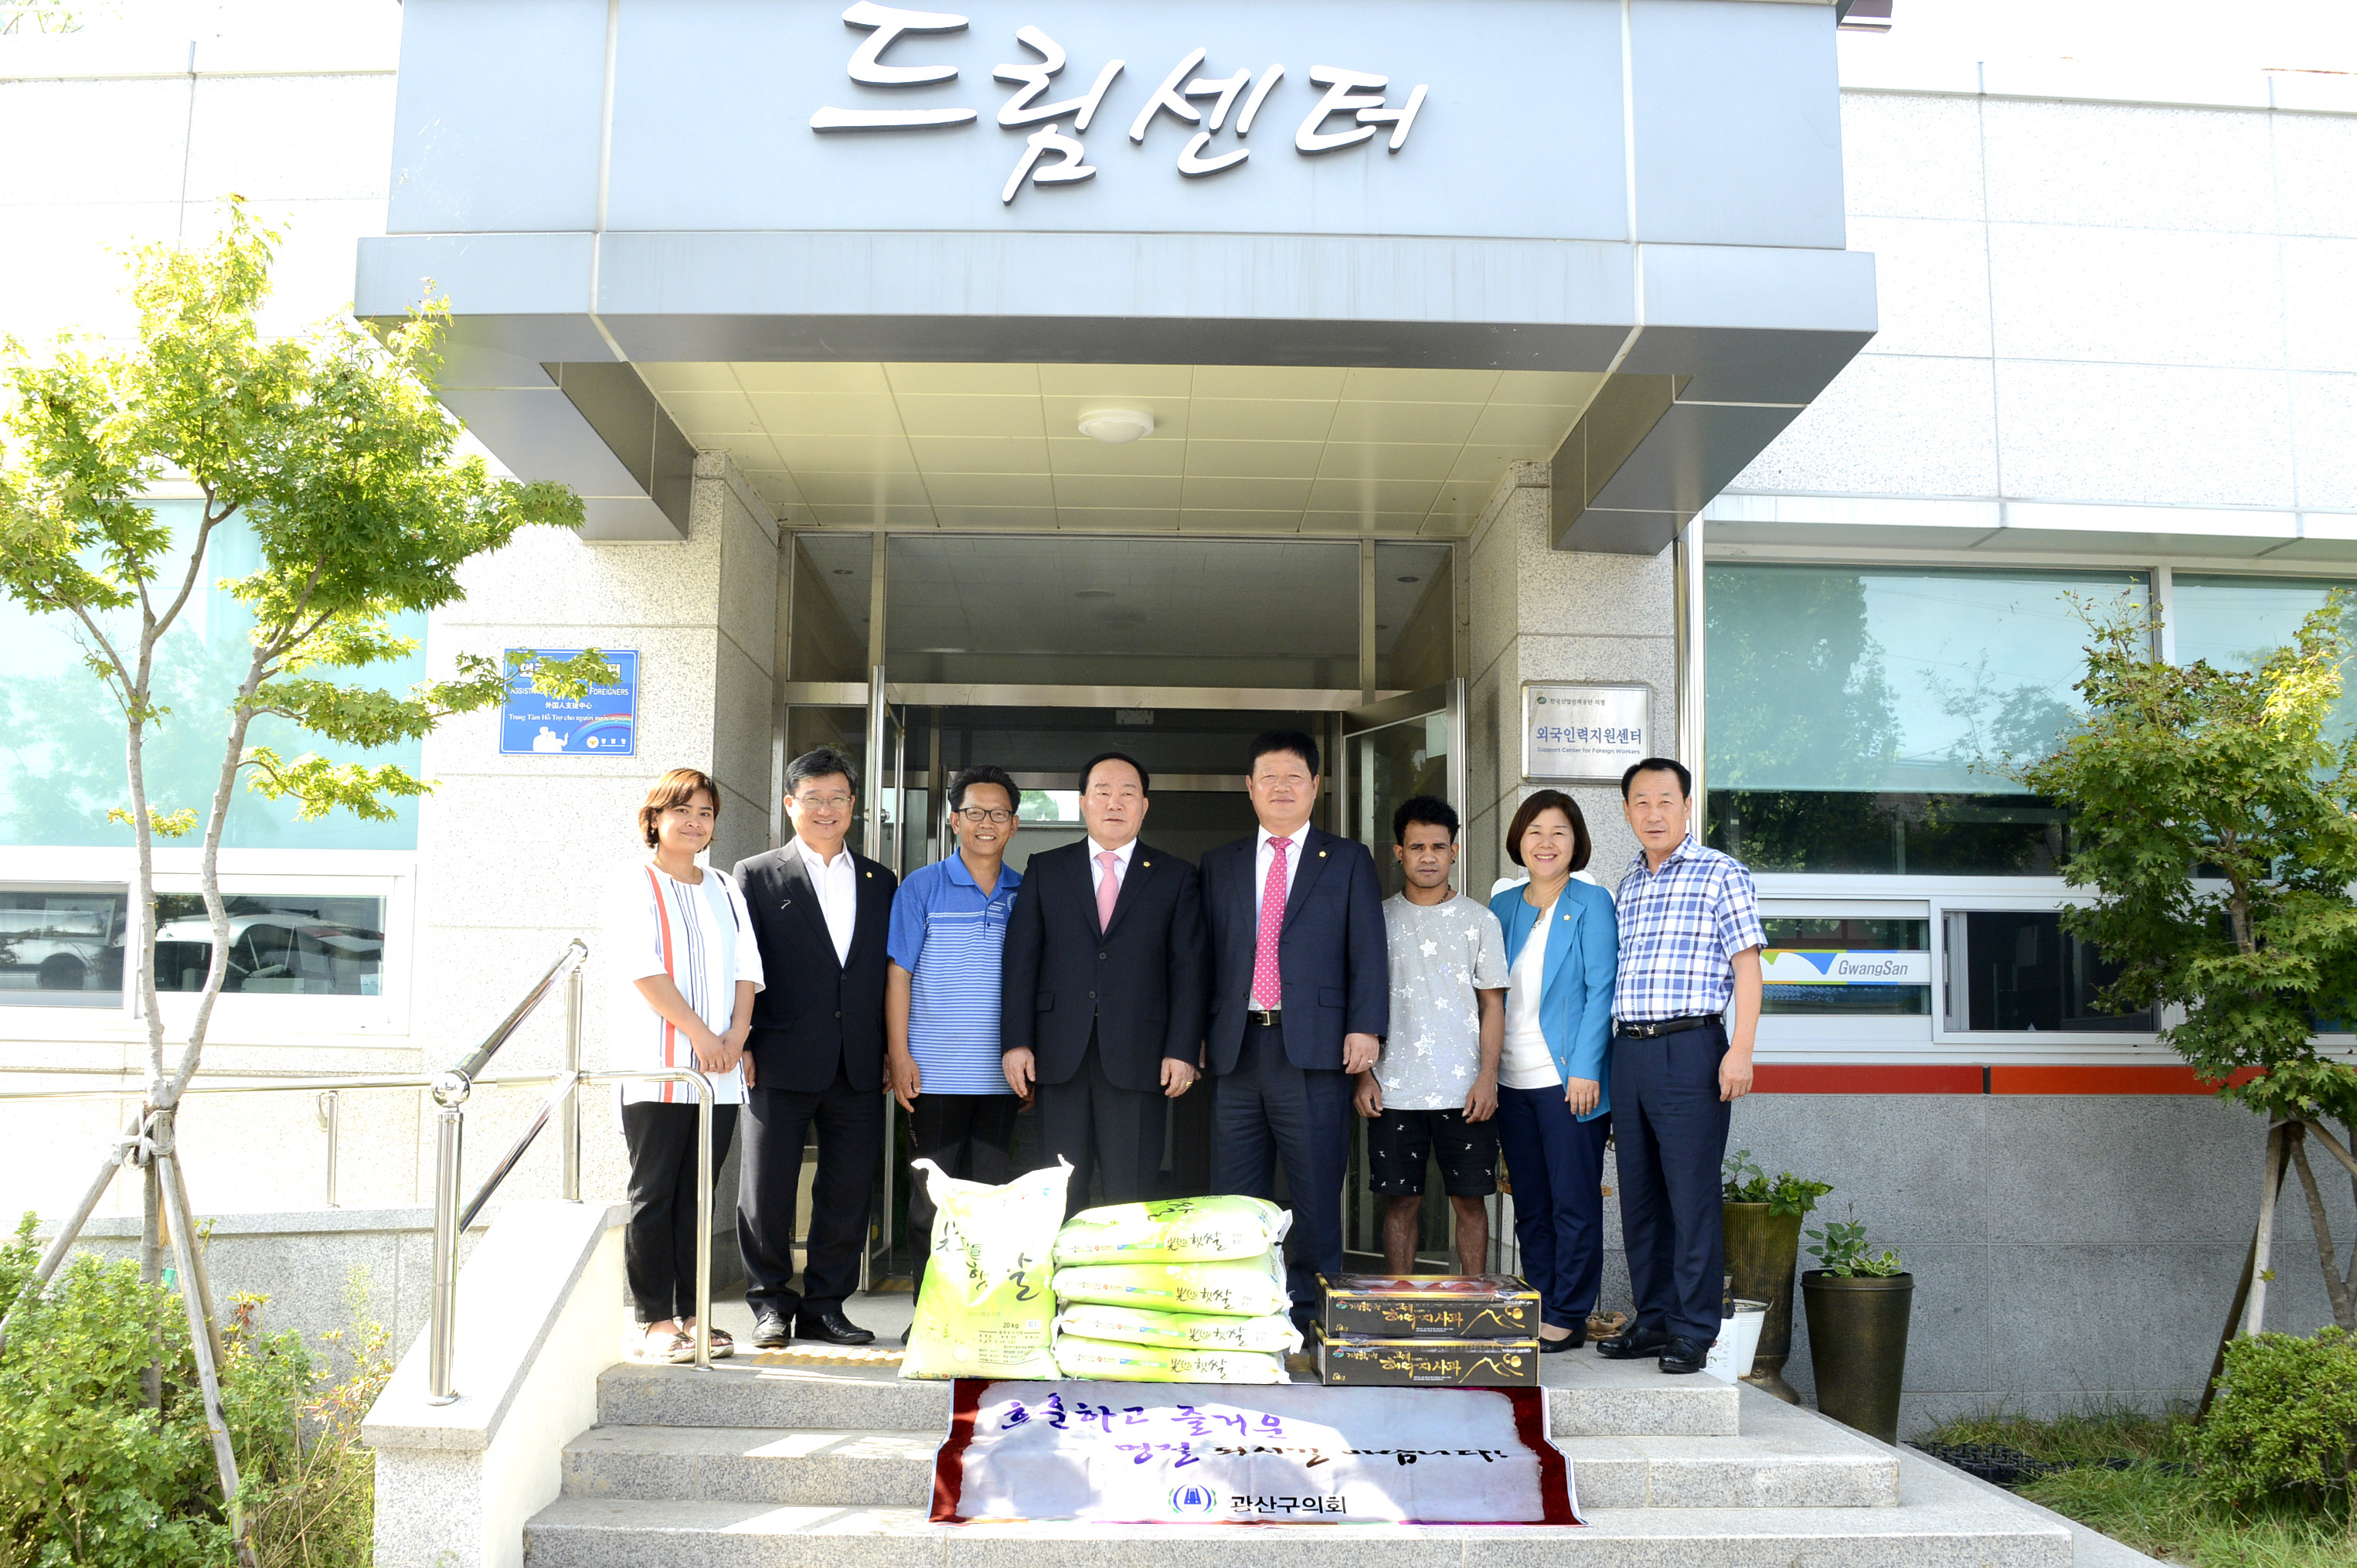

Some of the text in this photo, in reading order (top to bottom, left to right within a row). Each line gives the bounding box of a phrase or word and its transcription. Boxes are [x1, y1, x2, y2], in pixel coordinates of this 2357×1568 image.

[809, 1, 1430, 206] 드림센터
[590, 687, 629, 696] FOREIGNERS
[1536, 726, 1641, 745] 외국인력지원센터
[1838, 960, 1908, 976] GwangSan
[1230, 1495, 1347, 1515] 광산구의회
